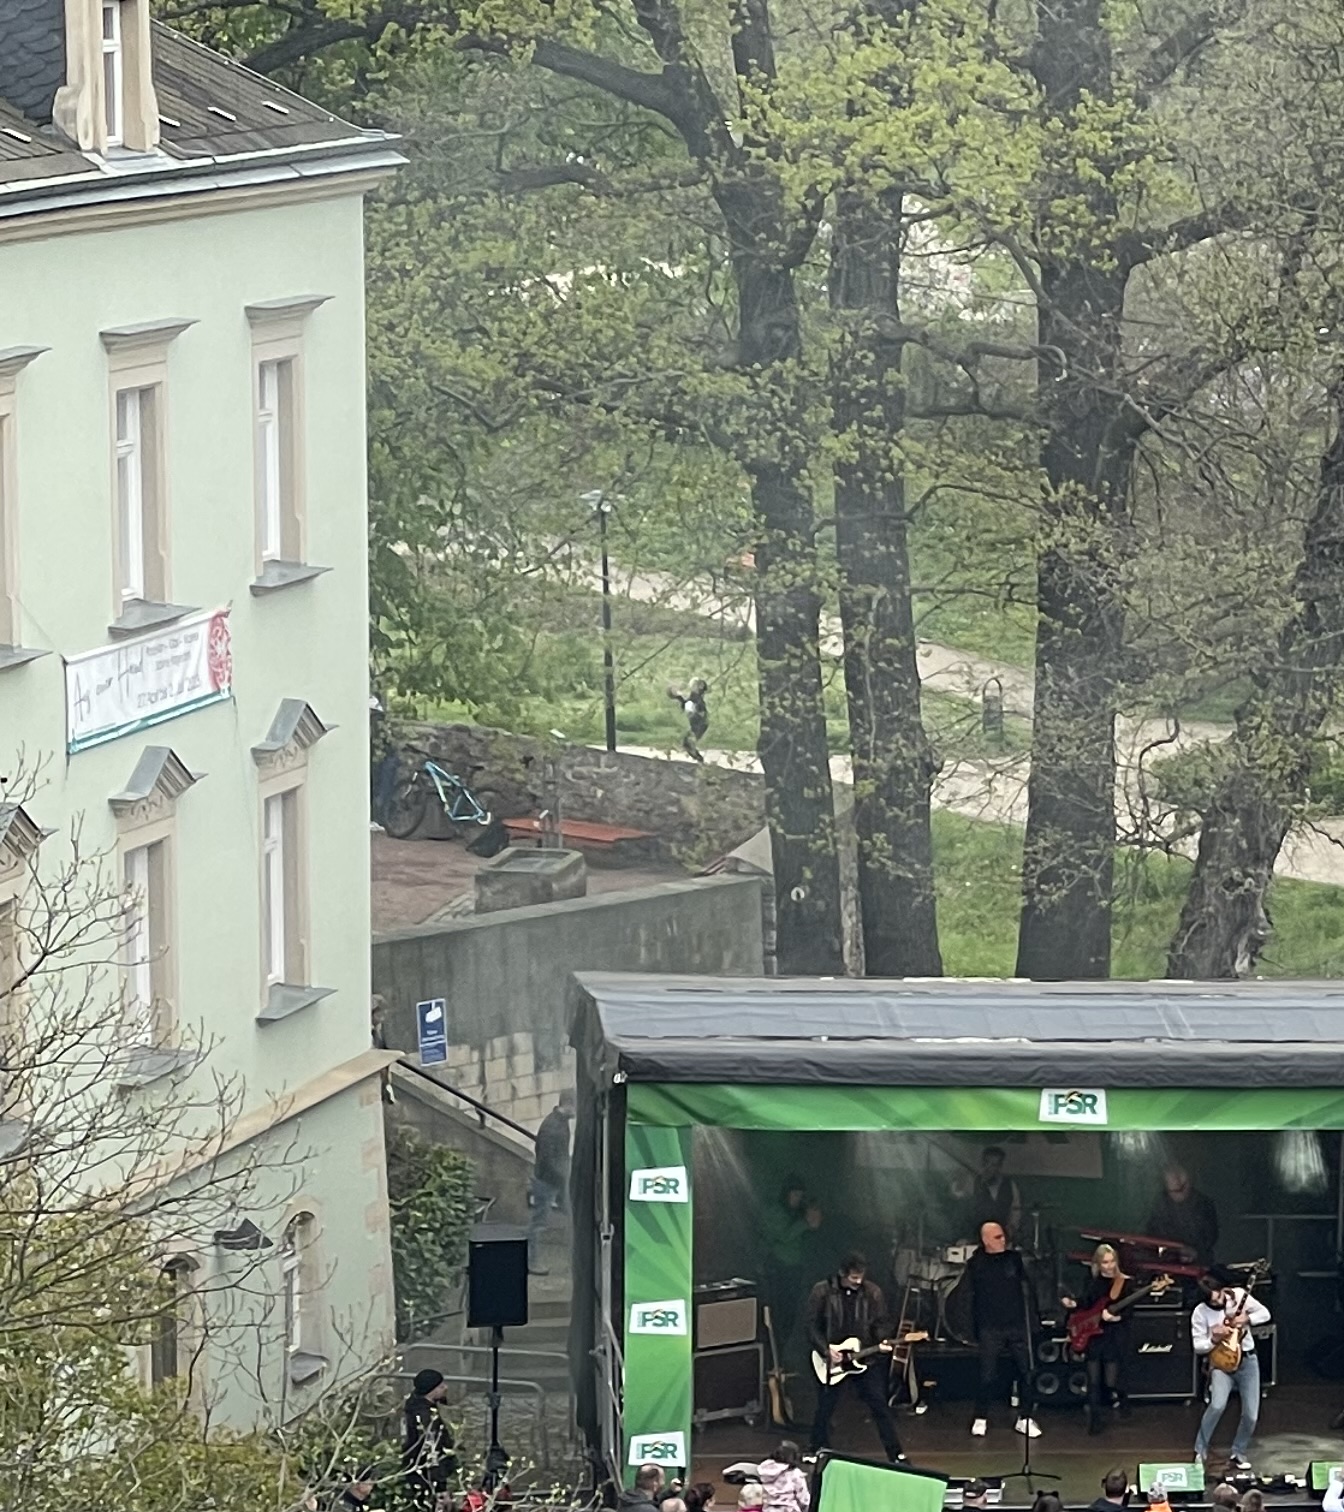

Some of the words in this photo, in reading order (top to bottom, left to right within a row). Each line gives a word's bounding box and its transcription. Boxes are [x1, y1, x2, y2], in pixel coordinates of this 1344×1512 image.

[1054, 1092, 1098, 1114] PSR
[643, 1176, 680, 1194] PSR
[642, 1309, 679, 1327] PSR
[641, 1442, 678, 1459] PSR
